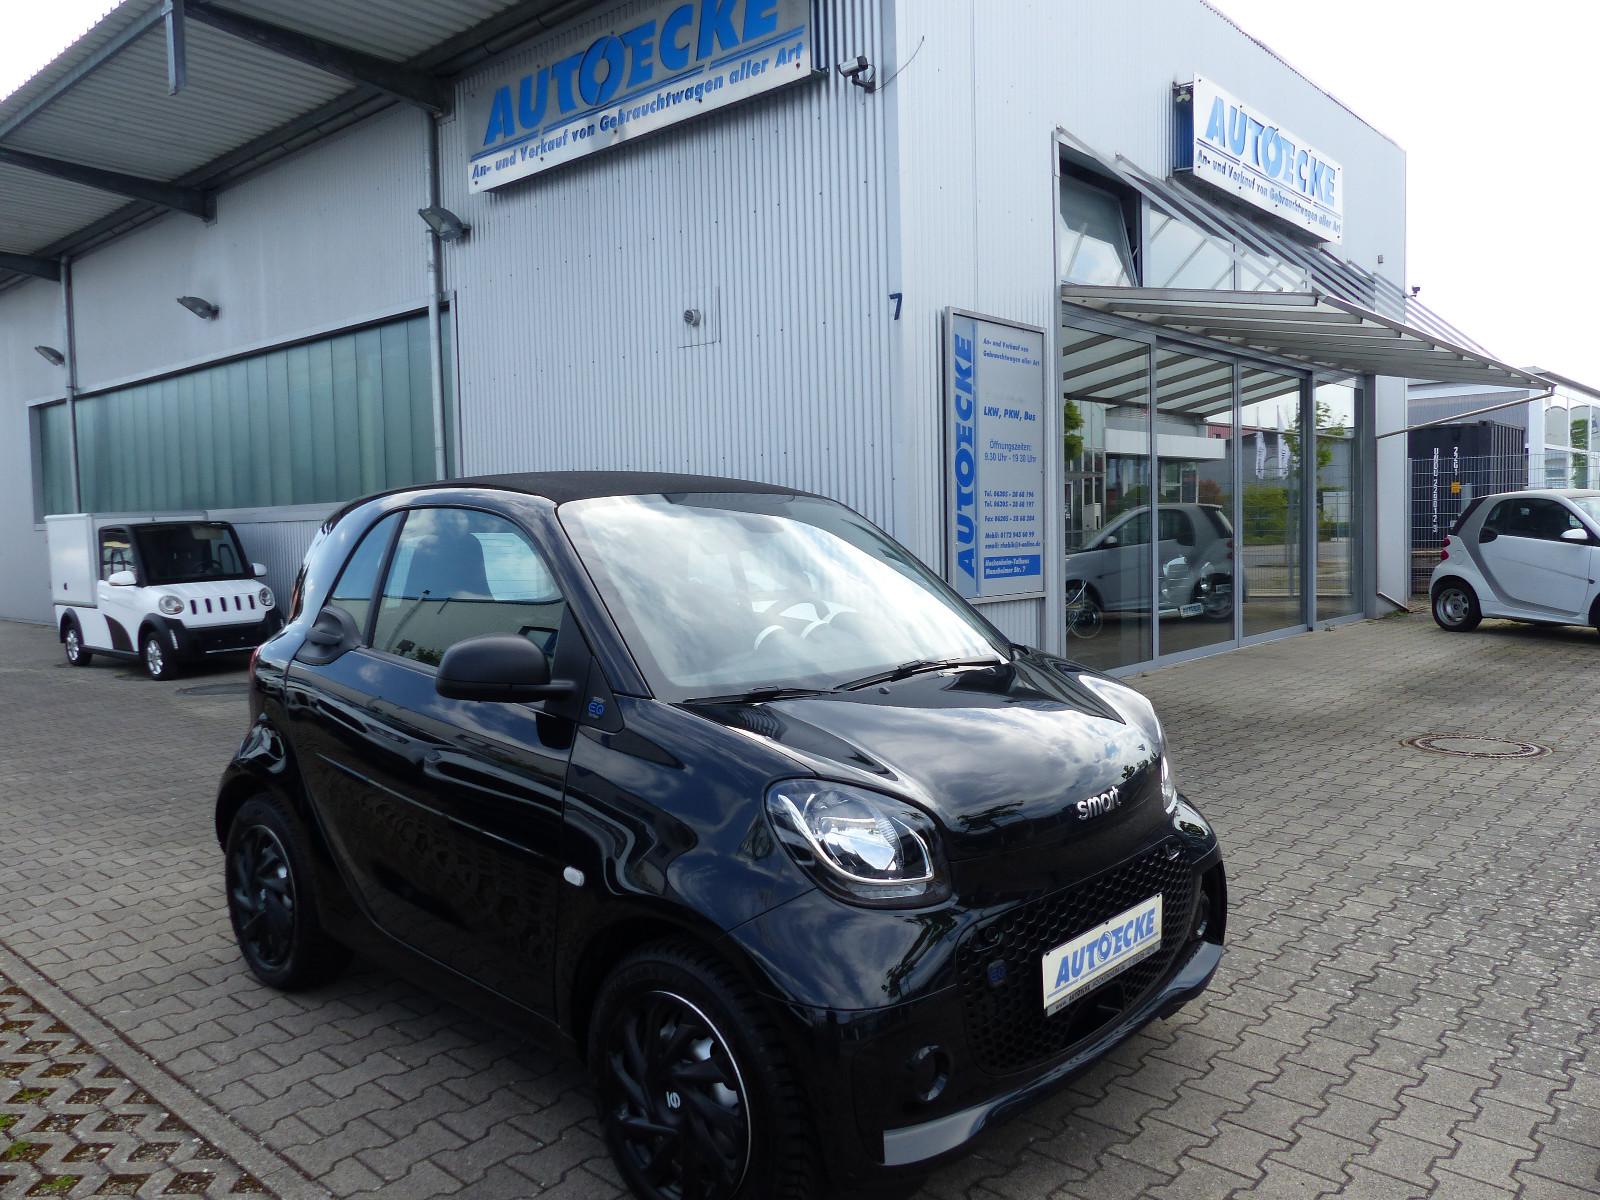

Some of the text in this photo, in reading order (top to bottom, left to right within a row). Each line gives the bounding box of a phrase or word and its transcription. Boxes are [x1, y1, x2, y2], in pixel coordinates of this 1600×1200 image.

[472, 42, 804, 179] An- und Verkauf von Gebrauchtwagen aller Art
[483, 0, 781, 146] AUTOECKE
[1198, 150, 1341, 233] An- und Verkauf von Gebrauchtwagen aller Art
[1205, 95, 1336, 207] AUTOECKE
[888, 292, 903, 321] 7
[983, 405, 1036, 422] LKW, PKW, Bus
[954, 333, 975, 579] AUTOECKE
[998, 453, 1007, 461] Uhr
[1027, 455, 1037, 463] Uhr
[1077, 786, 1120, 820] smart
[1055, 907, 1156, 989] AUTOECKE
